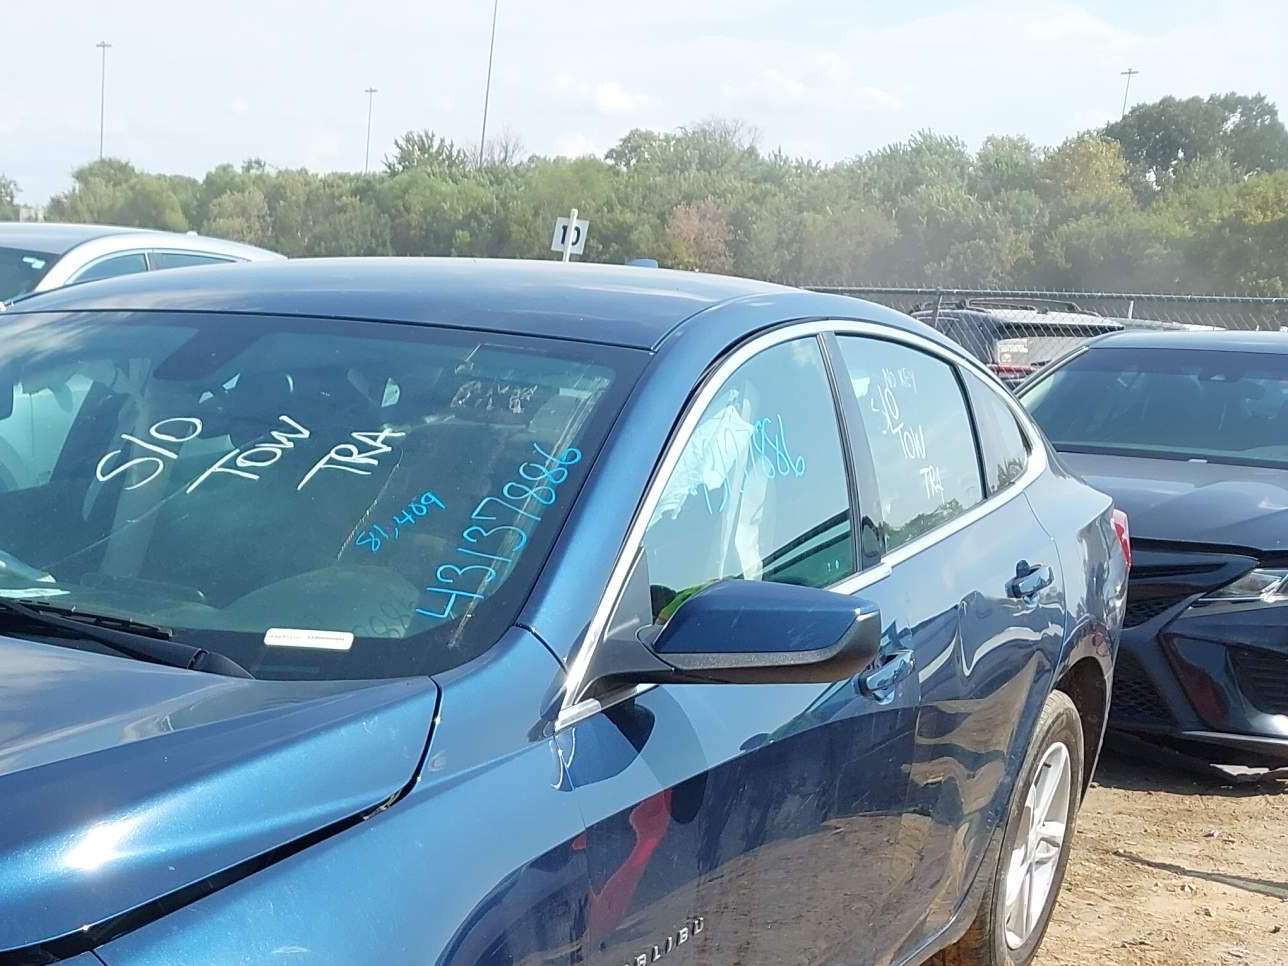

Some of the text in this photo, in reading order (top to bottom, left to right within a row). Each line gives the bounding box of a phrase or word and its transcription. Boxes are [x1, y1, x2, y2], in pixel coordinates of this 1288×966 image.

[186, 414, 311, 494] TOW
[297, 426, 407, 491] TRA
[892, 422, 927, 460] TOW
[355, 490, 447, 552] 81,409
[415, 442, 583, 619] 43137886
